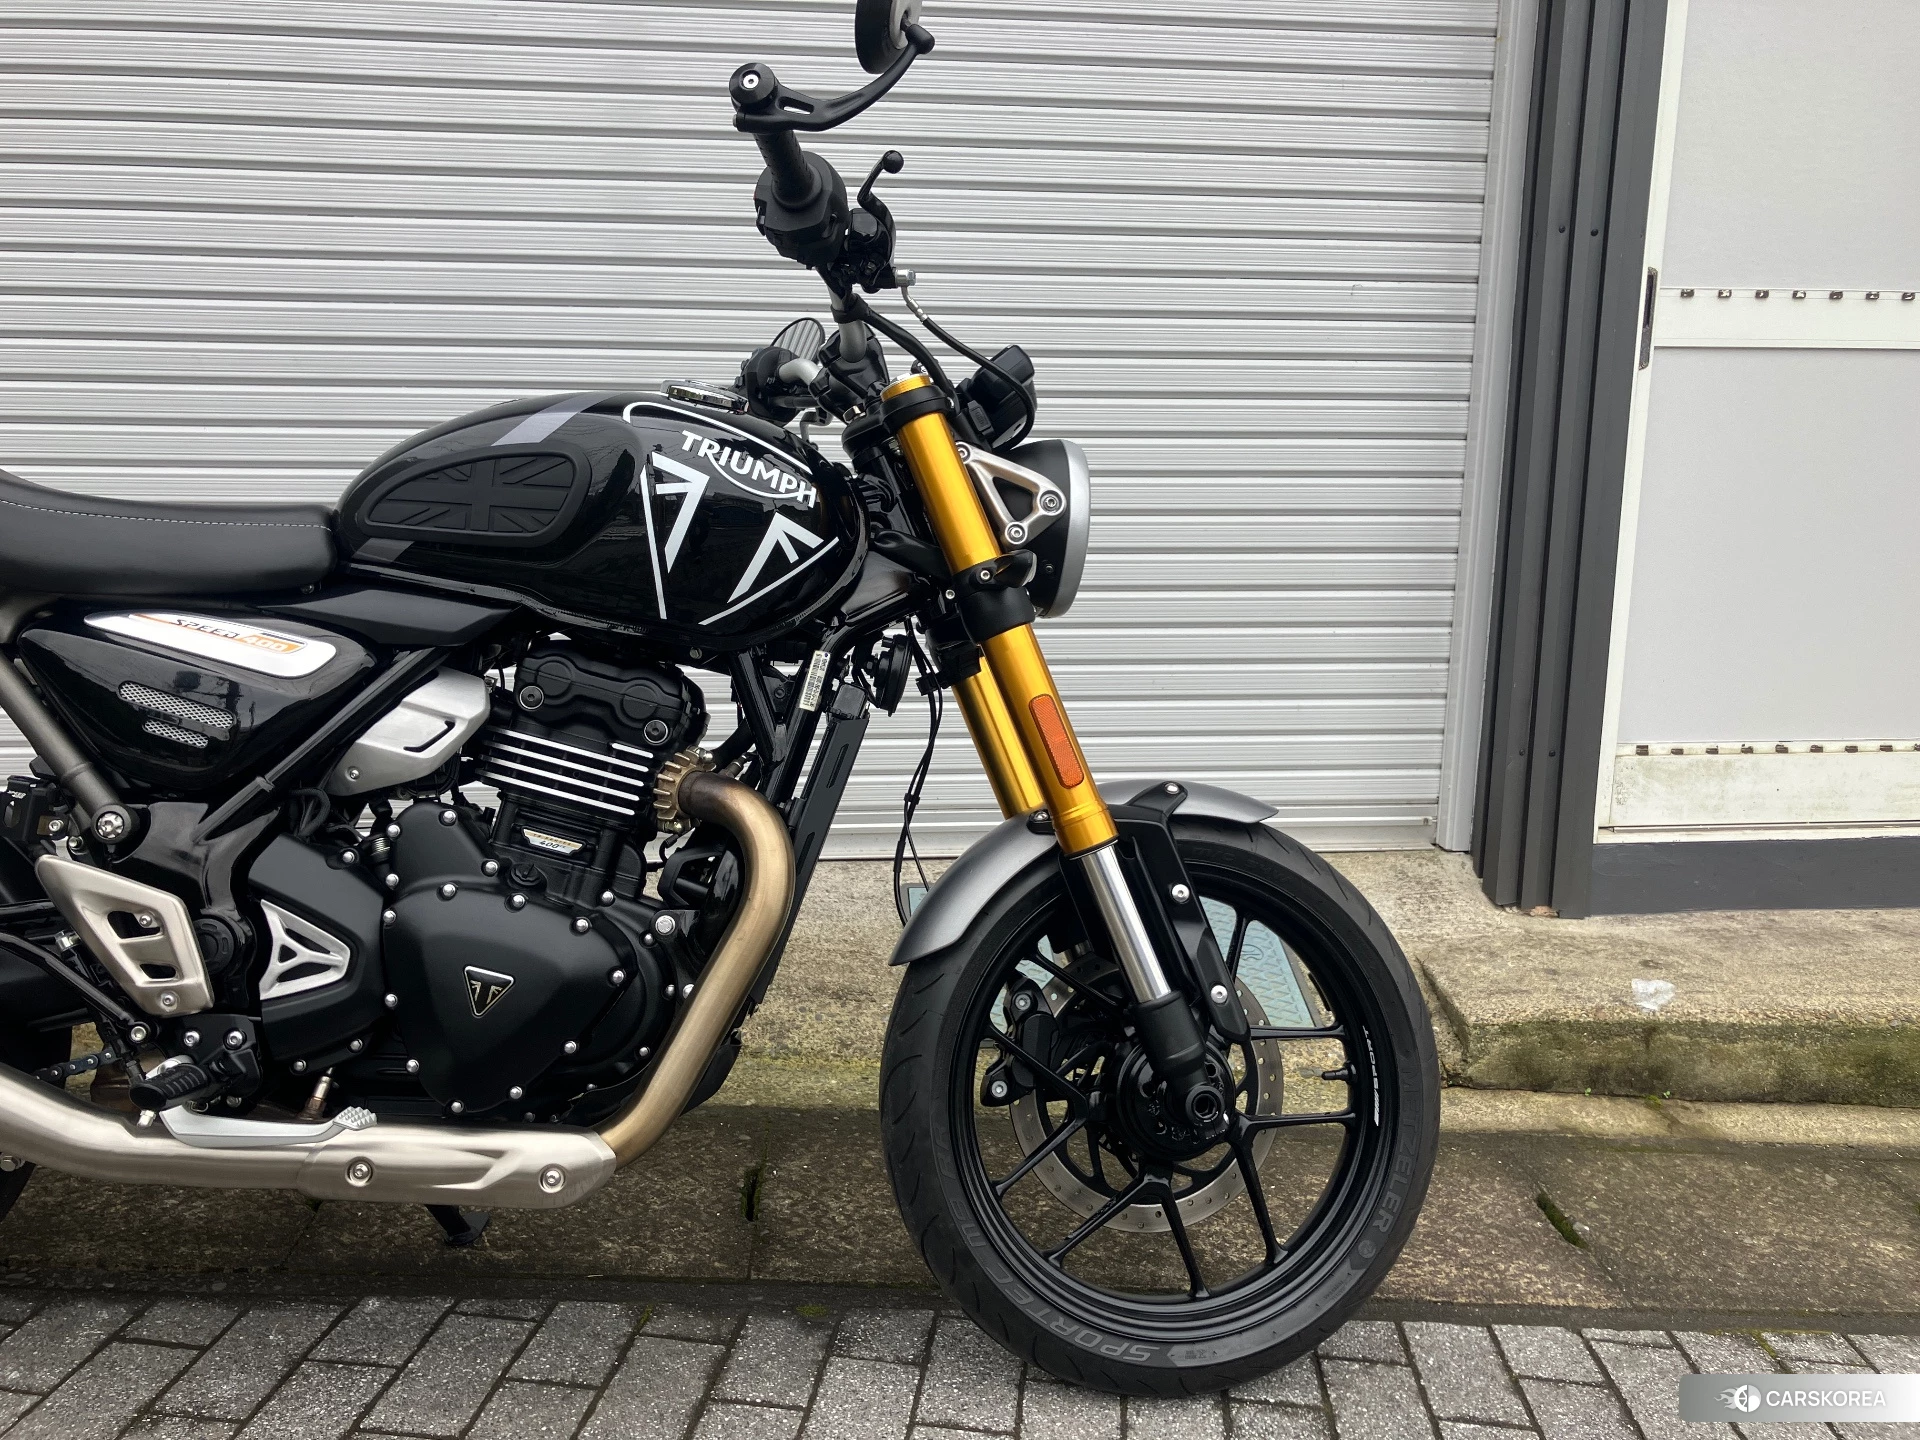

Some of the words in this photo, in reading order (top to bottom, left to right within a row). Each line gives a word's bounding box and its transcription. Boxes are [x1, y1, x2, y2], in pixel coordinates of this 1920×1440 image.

[681, 430, 817, 508] TRIUMPH
[175, 619, 240, 638] SPEED
[242, 635, 289, 651] 400
[1372, 1069, 1422, 1234] METZELER
[985, 1262, 1160, 1363] SPORTEC
